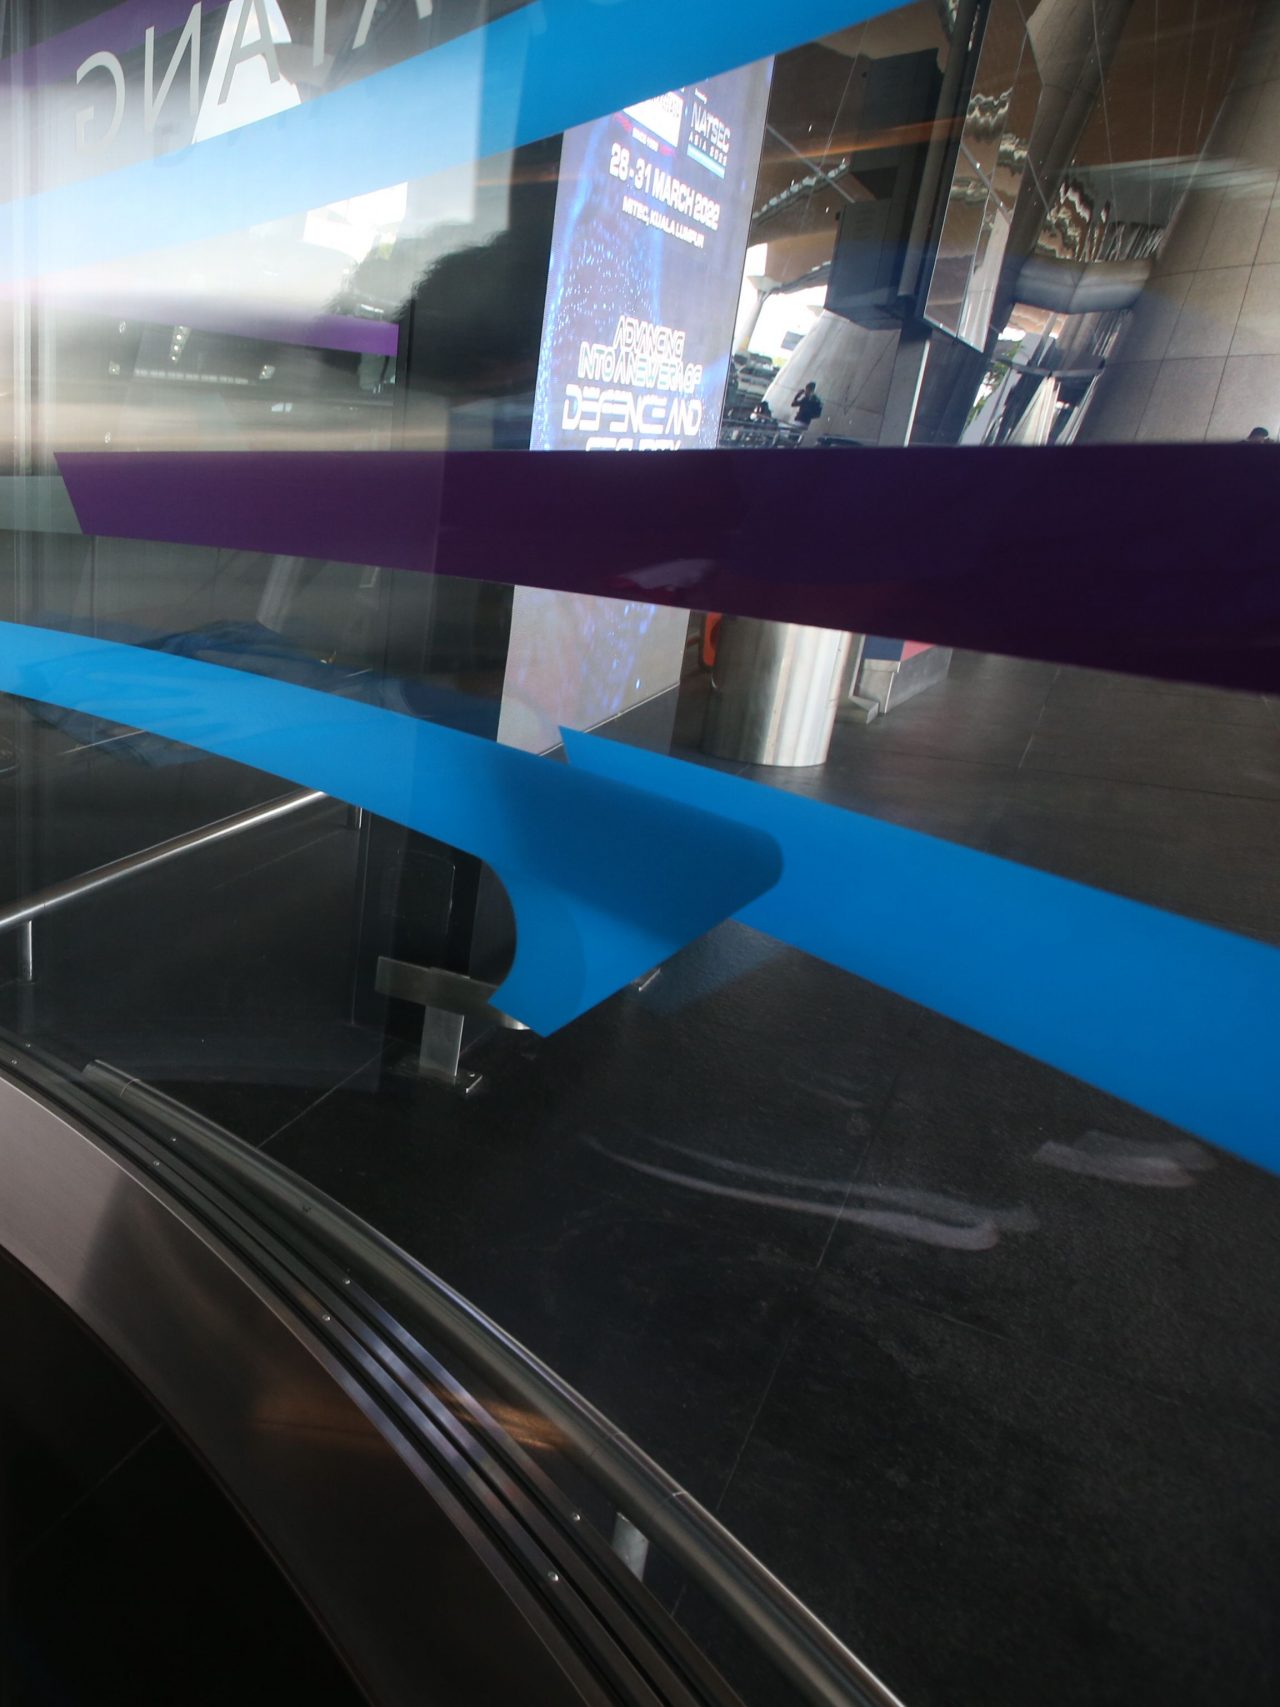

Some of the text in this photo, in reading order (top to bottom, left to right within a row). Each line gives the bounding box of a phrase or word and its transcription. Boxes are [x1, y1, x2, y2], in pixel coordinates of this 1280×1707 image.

[691, 102, 731, 154] NATSEC
[652, 167, 695, 217] MARCH
[693, 192, 721, 231] 2022
[577, 341, 615, 384] INTO
[613, 314, 686, 361] ADVANCING
[561, 383, 703, 436] DEFENCE AND
